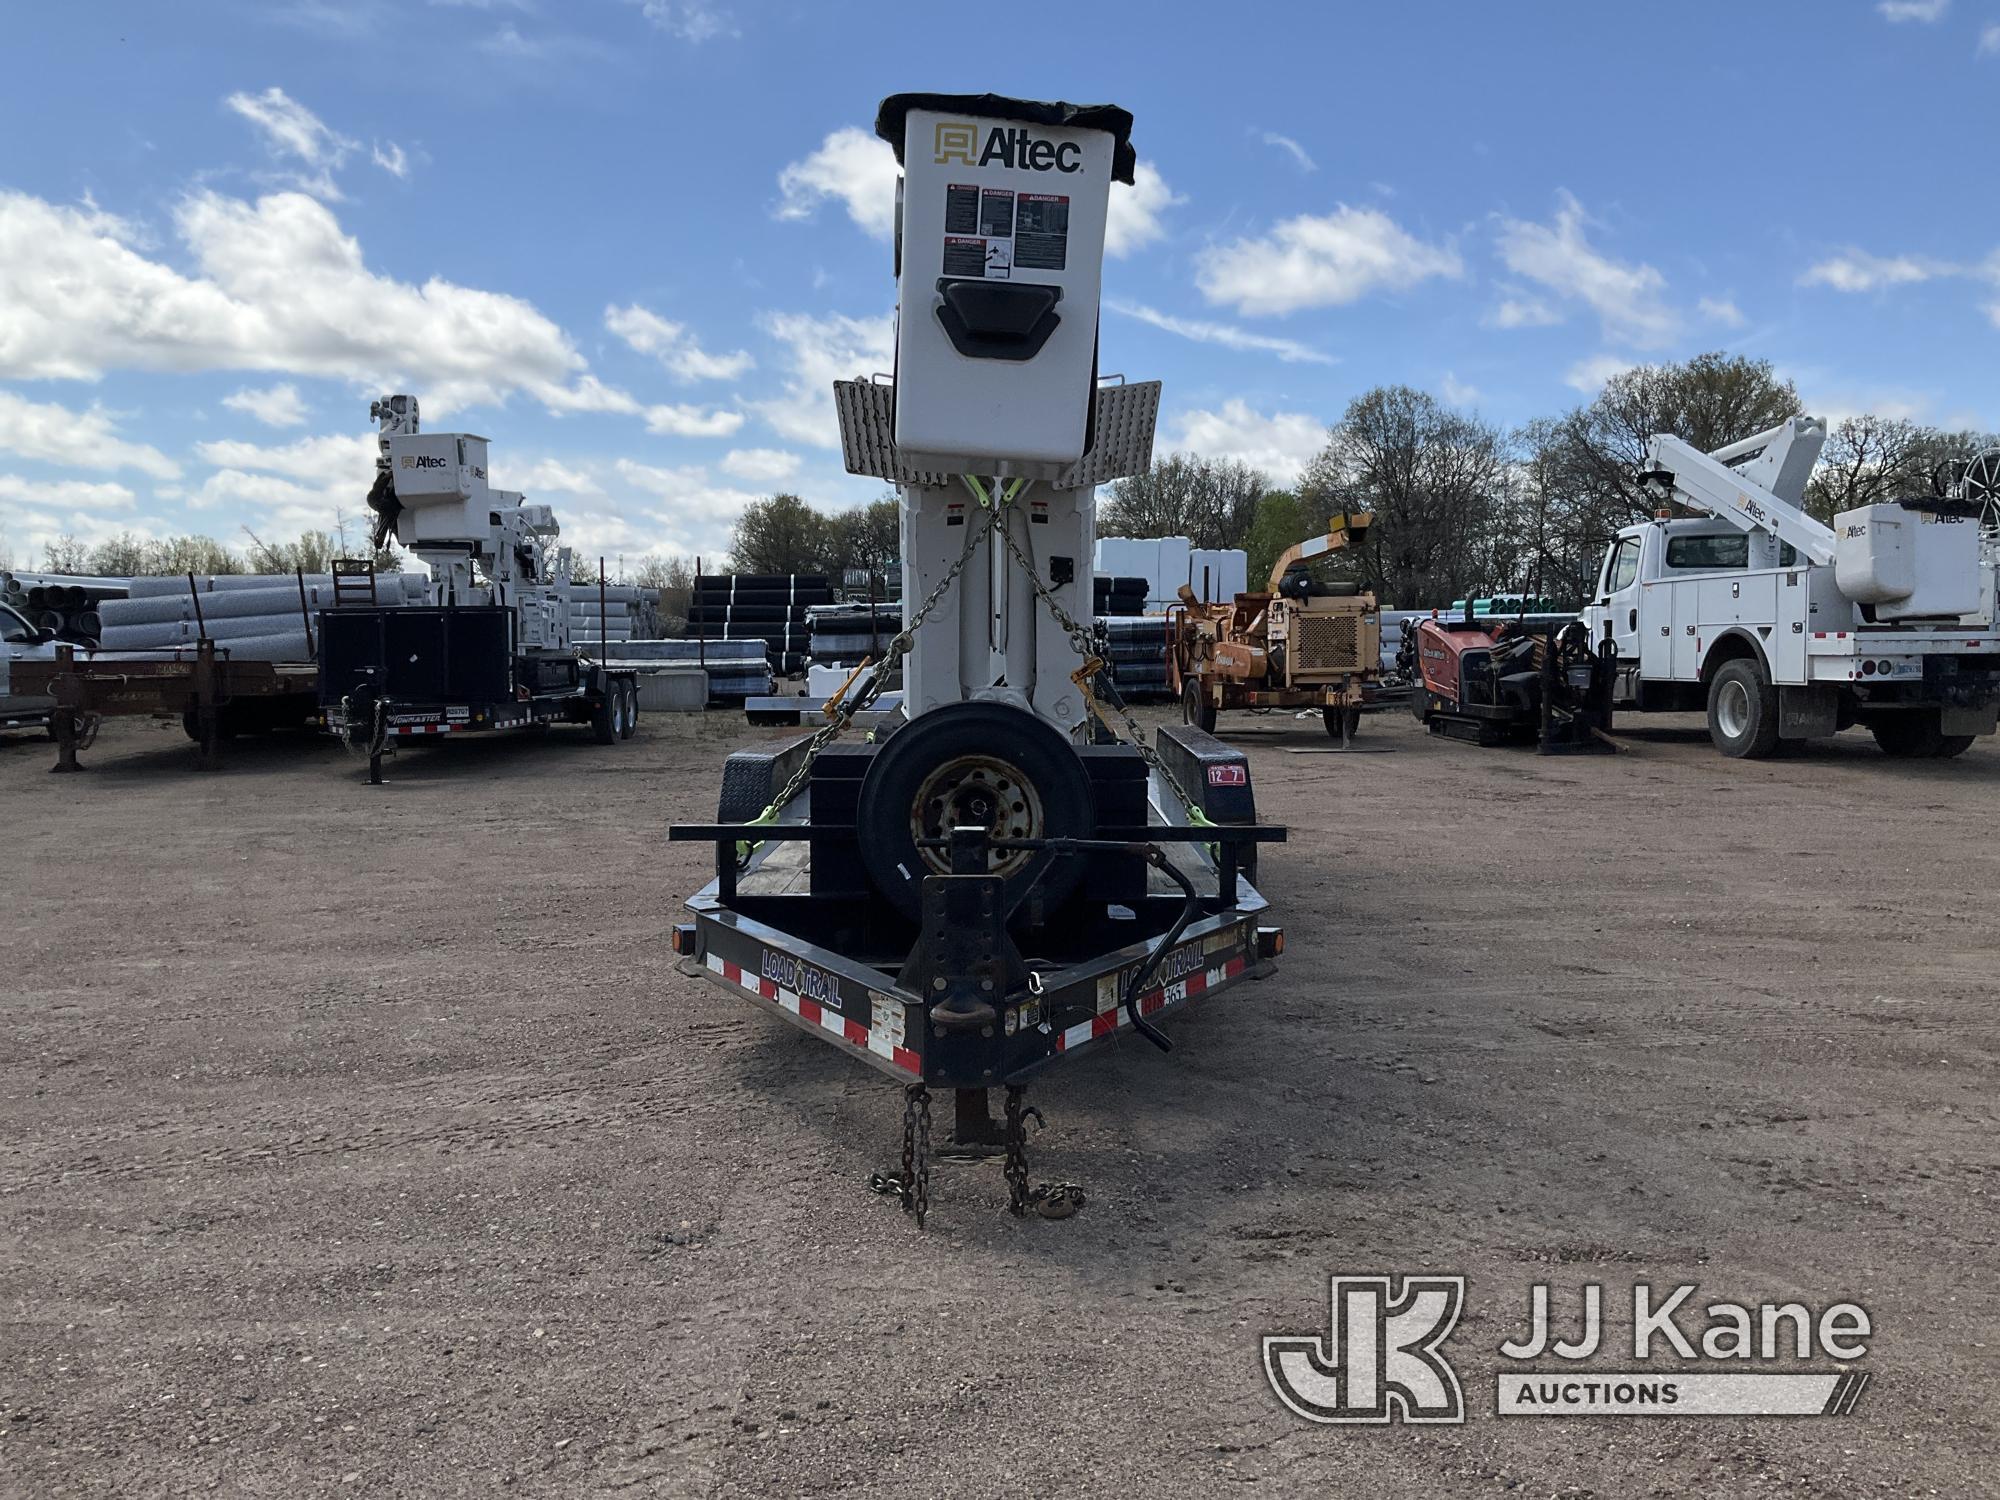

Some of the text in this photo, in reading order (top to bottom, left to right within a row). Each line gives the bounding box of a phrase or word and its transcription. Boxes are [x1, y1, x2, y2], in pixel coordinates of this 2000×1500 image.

[978, 127, 1082, 173] Altec
[416, 456, 446, 468] Altec
[1745, 499, 1766, 521] Altec
[1847, 525, 1866, 539] Altec
[1211, 770, 1222, 782] 12
[762, 949, 842, 1009] LOAD TRAIL
[1166, 983, 1182, 1006] 365
